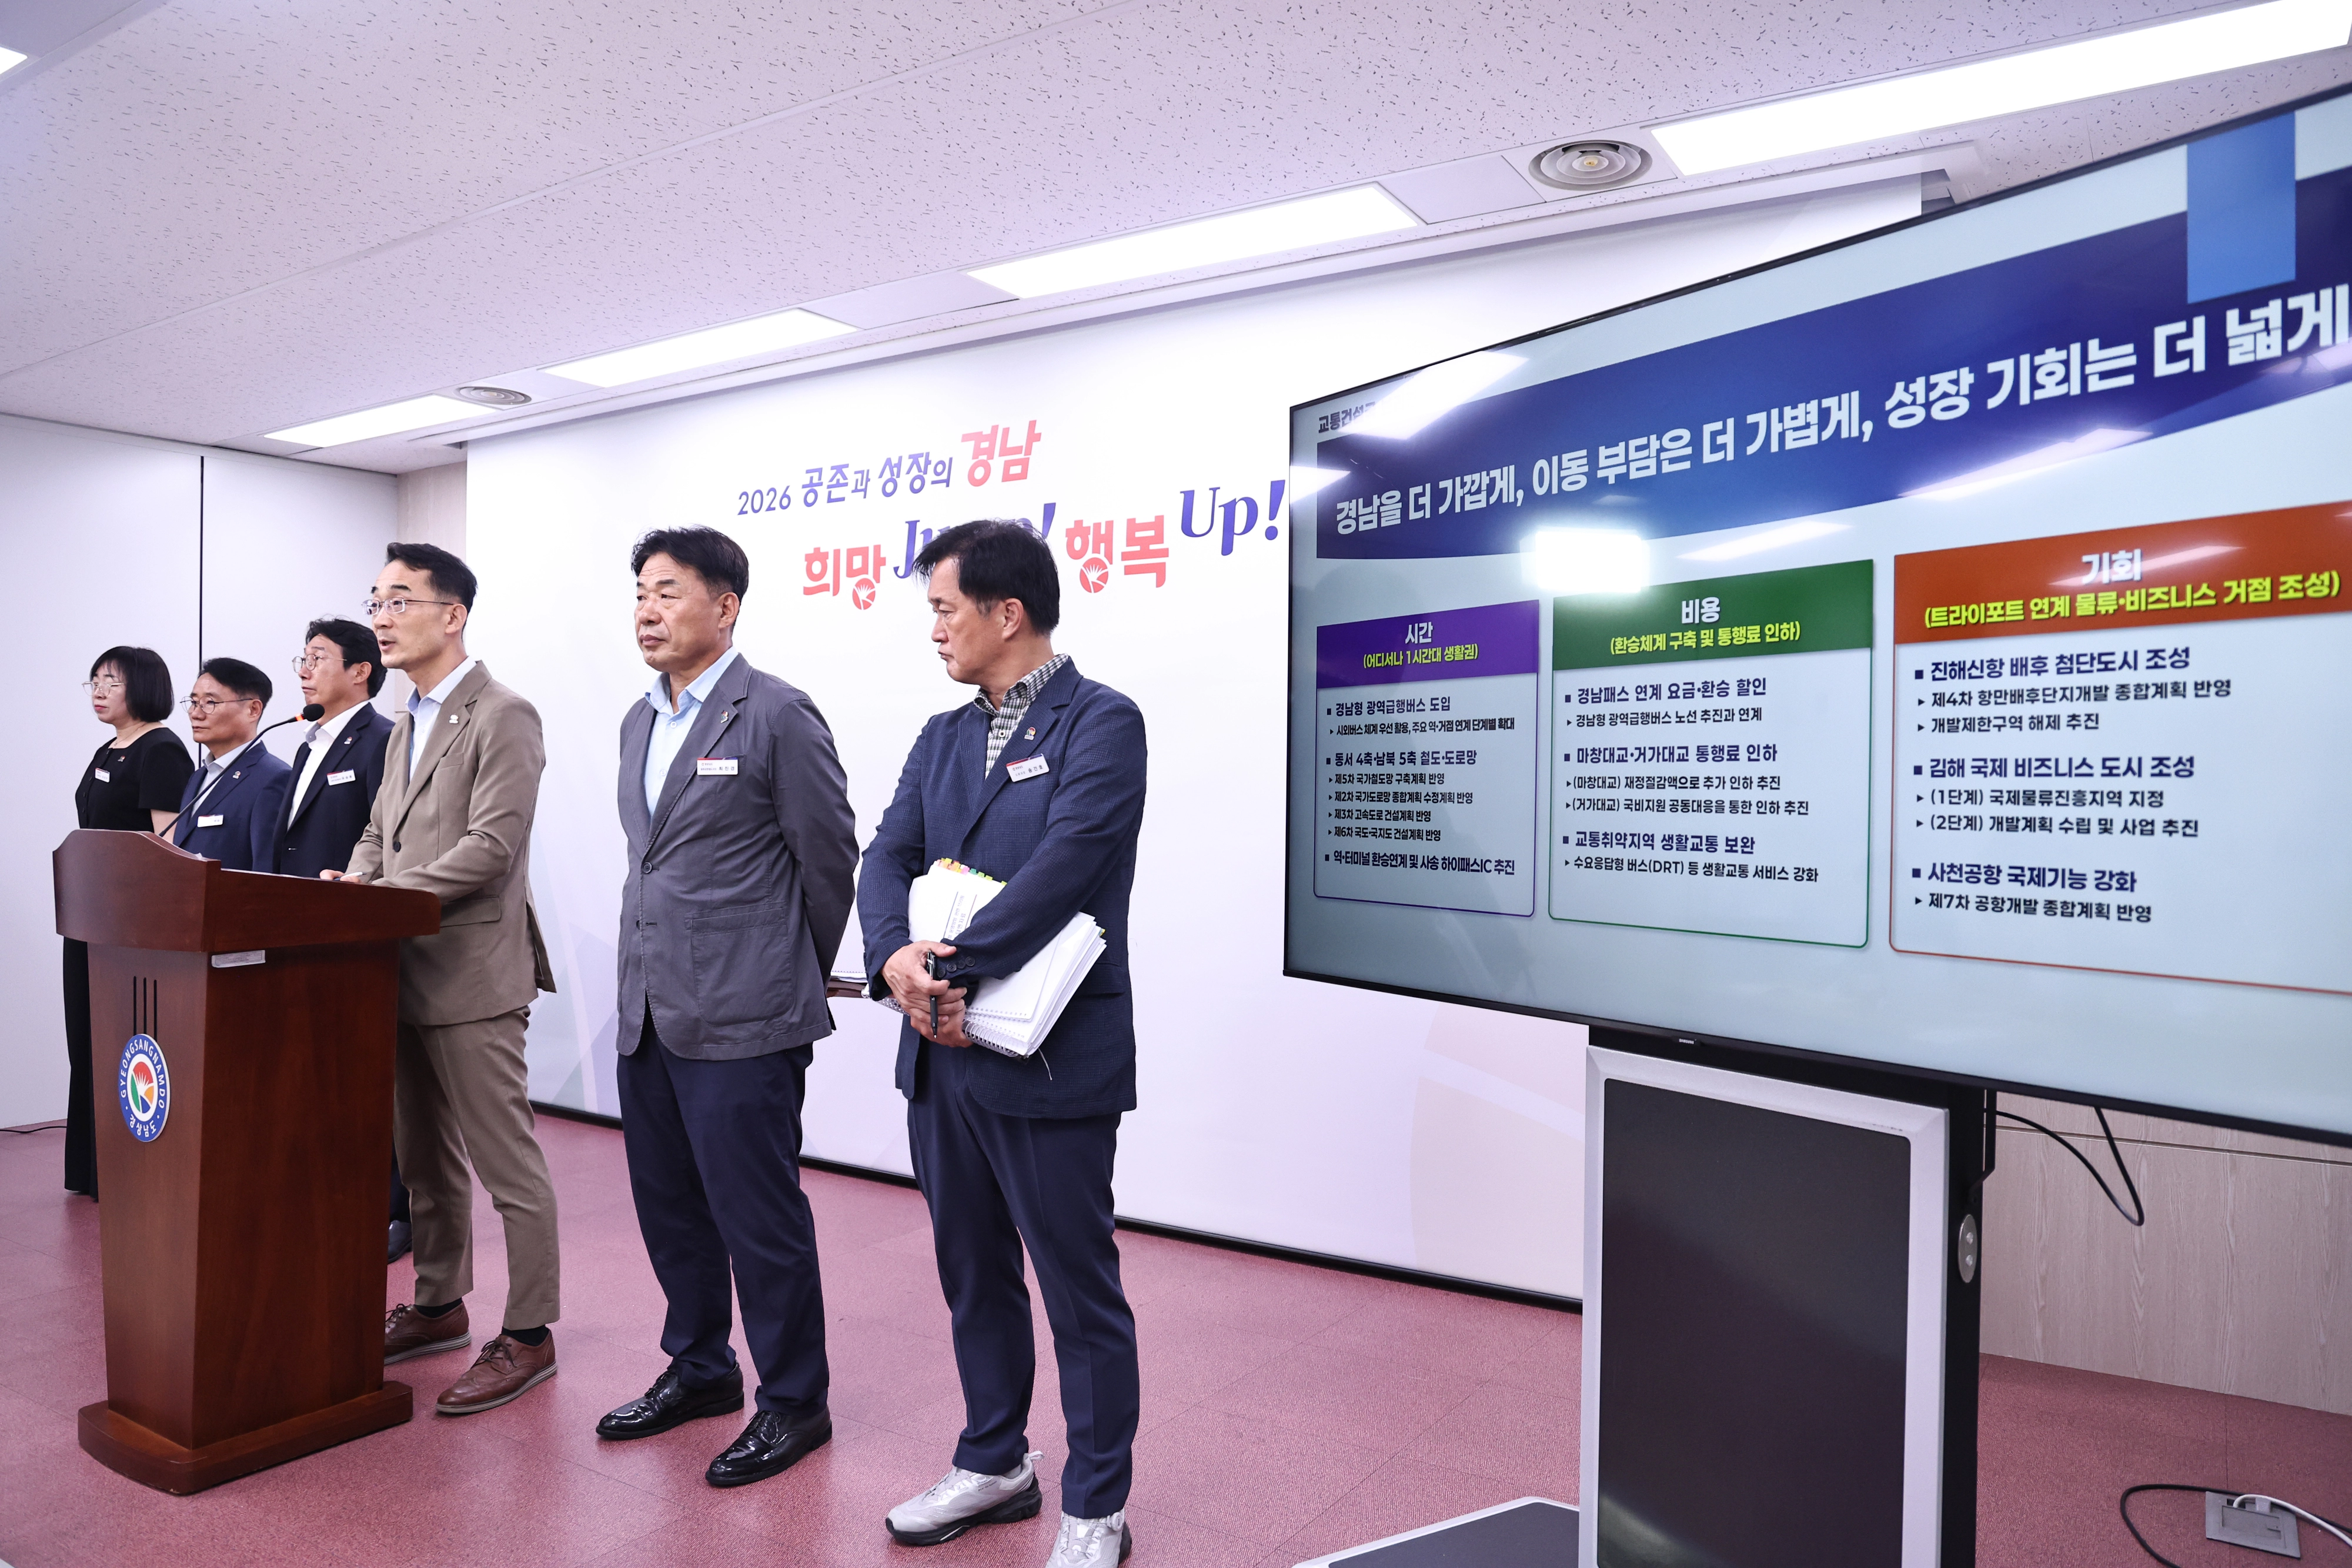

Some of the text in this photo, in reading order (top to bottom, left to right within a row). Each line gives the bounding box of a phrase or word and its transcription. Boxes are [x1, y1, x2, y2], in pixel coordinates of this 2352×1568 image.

[1337, 284, 2351, 534] 경남을 더 가깝게, 이동 부담은 더 가볍게, 성장 기회는 더 넓게
[738, 420, 1041, 515] 2026 공존과 성장의 경남
[803, 544, 886, 610] 희망
[1065, 515, 1169, 593] 행복
[1180, 480, 1285, 556] Up!
[2081, 549, 2143, 585] 기회
[1682, 597, 1720, 623] 비용
[1925, 600, 2024, 628] (트라이포트
[2030, 596, 2070, 619] 연계
[2224, 577, 2271, 603] 거점
[2278, 571, 2339, 599] 조성)
[1405, 622, 1433, 643] 시간
[1611, 621, 1800, 654] (환승체계 구축 및 통행료 인하)
[1364, 651, 1403, 668] (어디서나
[1444, 644, 1478, 661] 생활권)
[1932, 647, 2189, 681] 진해신항 배후 첨단도시 조성
[1578, 686, 1629, 704] 경남패스
[1635, 684, 1661, 701] 연계
[1737, 678, 1766, 696] 할인
[1932, 680, 2230, 707] 제4차 항만배후단지개발 종합계획 반영
[1337, 697, 1450, 716] 경남형 광역급행버스 도입
[1576, 708, 1761, 727] 경남형 광역급행버스 노선 추진과 연계
[1337, 724, 1363, 735] 시외버스
[1379, 723, 1392, 734] 우선
[1395, 723, 1411, 734] 활용,
[1412, 722, 1426, 733] 주요
[1455, 720, 1471, 731] 연계
[1932, 714, 2099, 733] 개발제한구역 해제 추진
[1335, 753, 1352, 766] 동서
[1399, 751, 1416, 765] 5축
[1696, 745, 1739, 762] 통행료
[1747, 744, 1777, 761] 인하
[1930, 757, 2194, 777] 김해 국제 비즈니스 도시 조성
[1335, 773, 1444, 784] 제5차 국가철도망 구축계획 반영
[1574, 776, 1780, 790] (마창대교) 재정절감액으로 추가 인하 추진
[1335, 791, 1472, 804] 제2차 국가도로망 종합계획 수정계획 반영
[1573, 798, 1808, 815] (거가대교) 국비지원 공동대응을 통한 인하 추진
[1932, 790, 2163, 807] (1단계) 국제물류진흥지역 지정
[1335, 809, 1431, 822] 제3차 고속도로 건설계획 반영
[1931, 815, 2198, 837] (2단계) 개발계획 수립 및 사업 추진
[1334, 827, 1353, 837] 제6차
[1394, 828, 1423, 841] 건설계획
[1426, 830, 1441, 841] 반영
[1576, 831, 1755, 854] 교통취약지역 생활교통 보완
[1409, 855, 1418, 868] 및
[1421, 855, 1439, 870] 사송
[1441, 857, 1492, 872] 하이패스IC
[1494, 859, 1514, 875] 추진
[1574, 856, 1818, 882] 수요응답형 버스(DRT) 등 생활교통 서비스 강화
[1929, 863, 2137, 892] 사천공항 국제기능 강화
[1929, 893, 2151, 922] 제7차 공항개발 종합계획 반영
[121, 1039, 165, 1108] GYEONGSANGNAMDO
[130, 1114, 156, 1137] 경상남도
